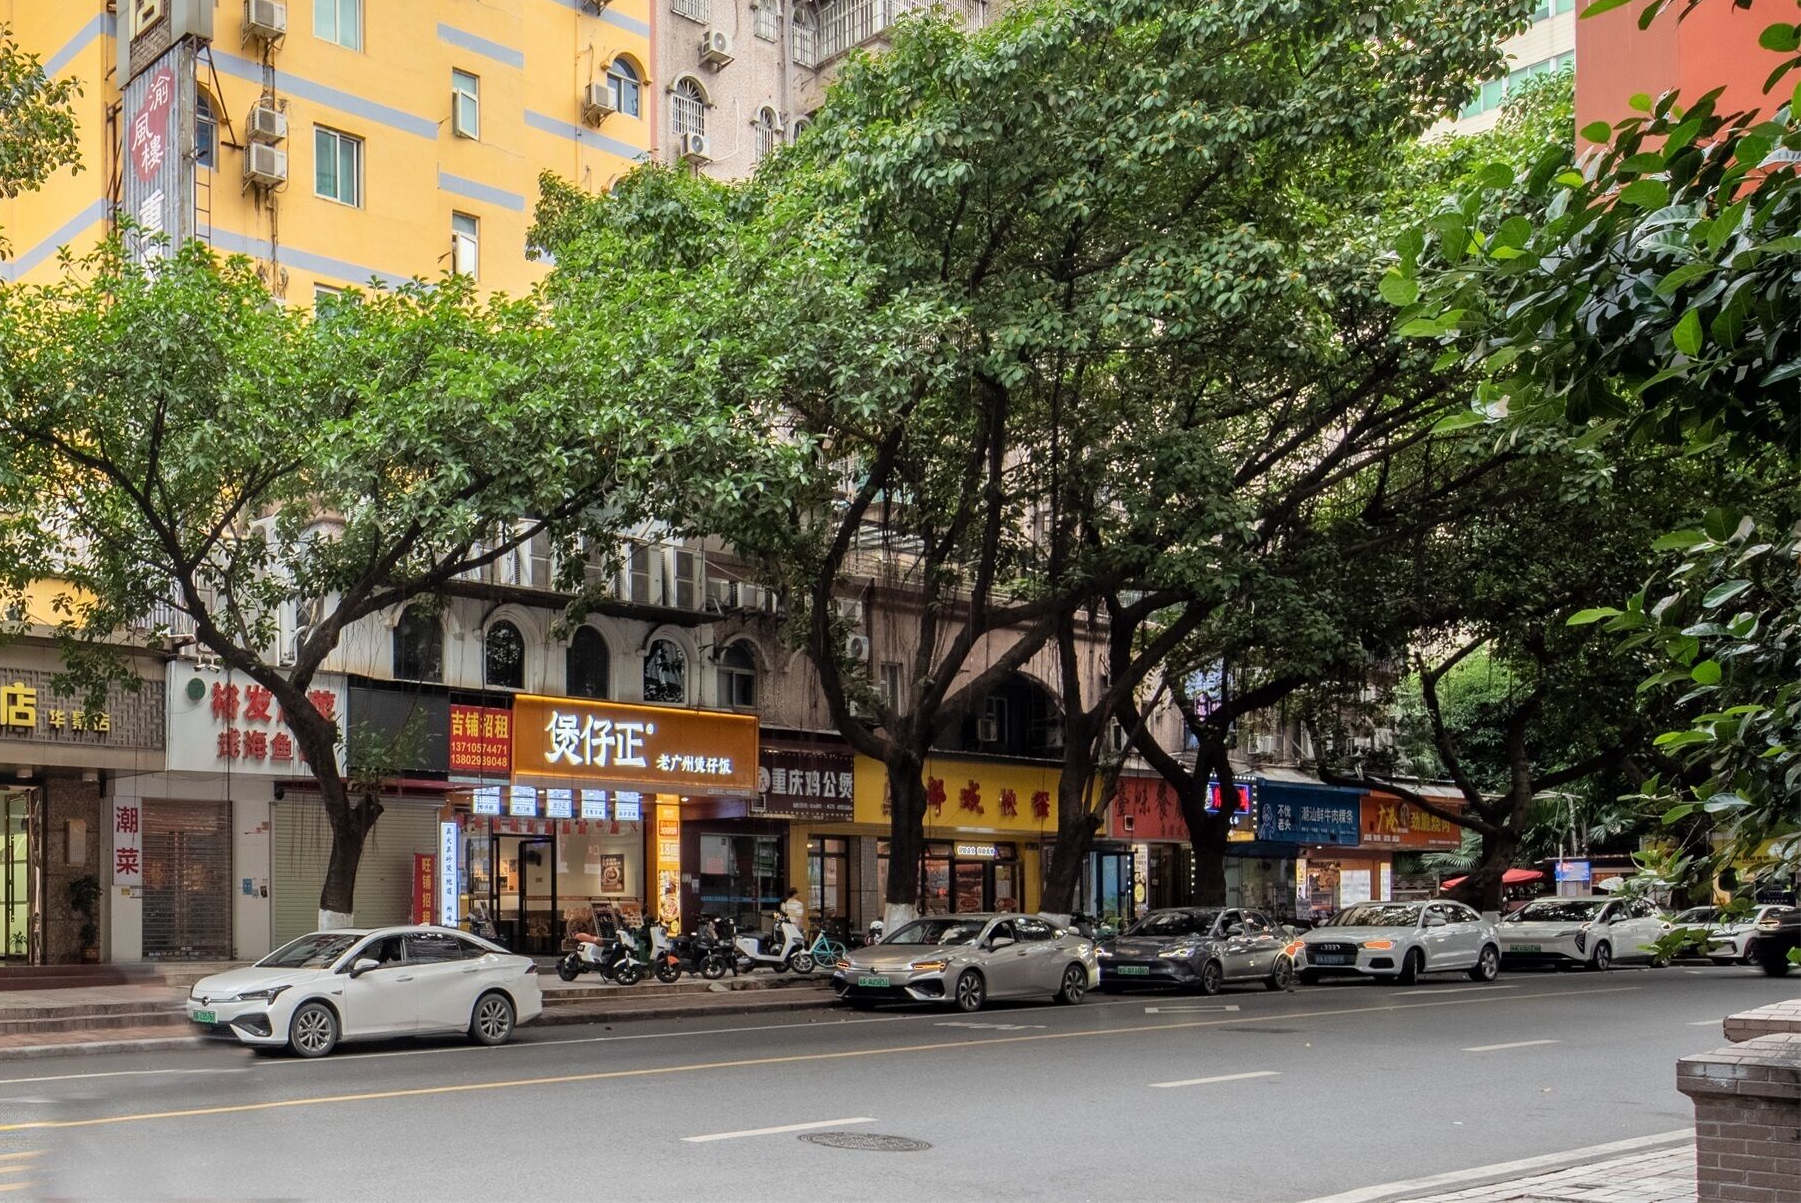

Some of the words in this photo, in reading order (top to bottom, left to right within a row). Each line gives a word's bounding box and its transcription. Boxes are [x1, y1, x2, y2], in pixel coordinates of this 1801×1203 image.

[131, 75, 171, 174] 渝風樓
[211, 681, 336, 723] 裕发菜
[451, 710, 509, 739] 吉铺招租
[544, 710, 647, 768] 煲仔正
[451, 741, 507, 755] 13710574471
[655, 753, 733, 775] 老广州煲仔饭
[771, 767, 853, 798] 重庆鸡公煲
[116, 806, 139, 874] 潮菜
